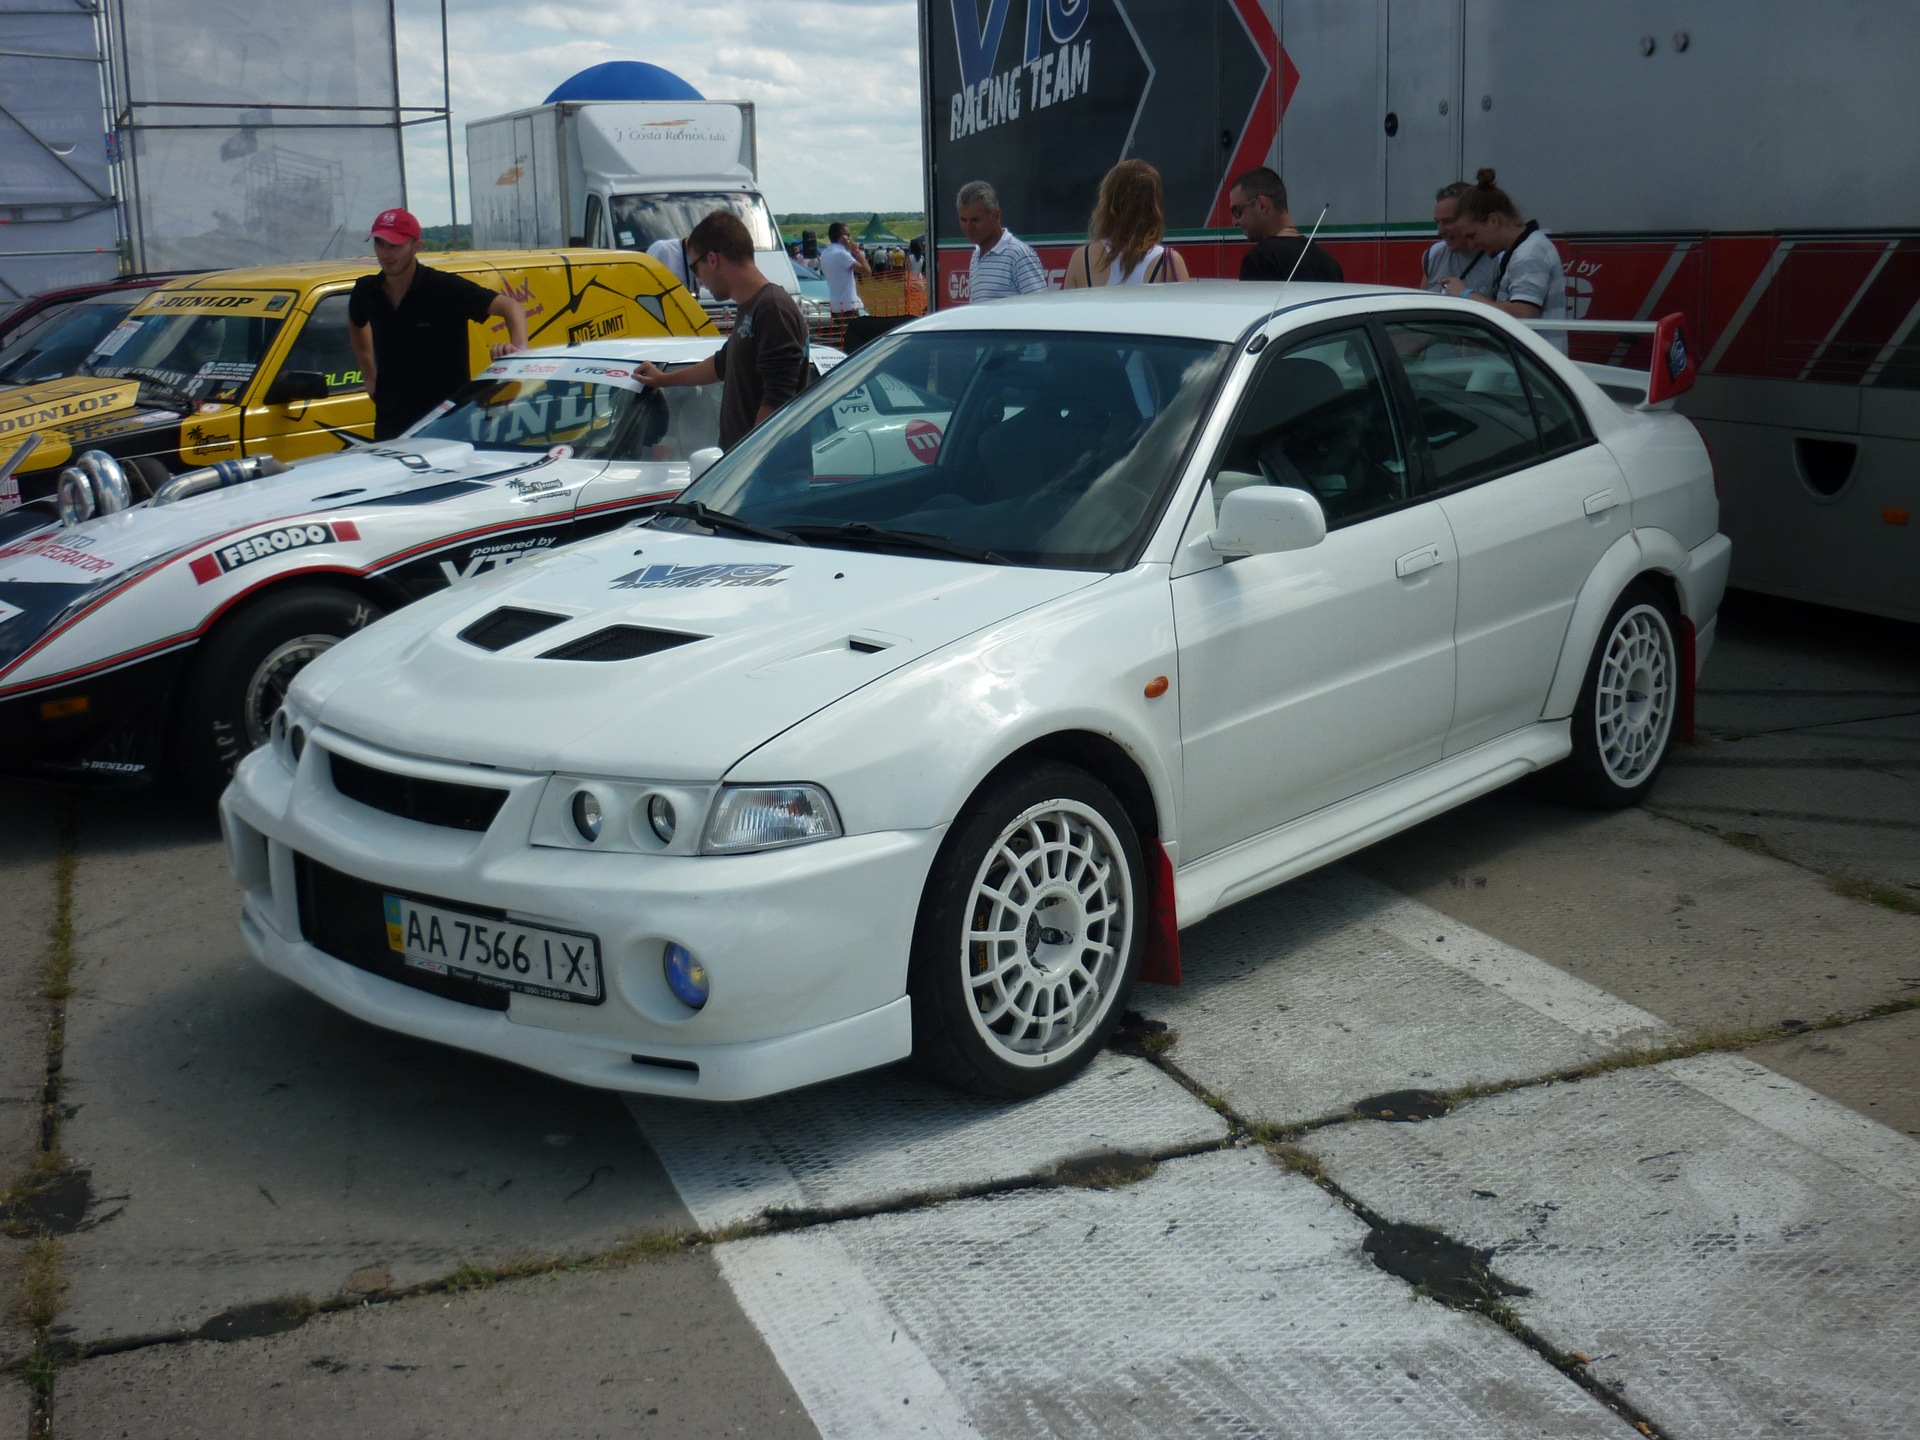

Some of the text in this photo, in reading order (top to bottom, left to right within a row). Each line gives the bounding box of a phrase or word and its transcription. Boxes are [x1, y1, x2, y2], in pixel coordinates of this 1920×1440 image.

[950, 39, 1091, 142] RACING TEAM
[629, 131, 661, 141] Costa
[1577, 260, 1602, 277] by
[162, 296, 256, 308] DUNLOP
[595, 314, 624, 337] LIMIT
[0, 392, 119, 433] DUNLOP
[838, 404, 870, 415] VTG
[222, 525, 326, 568] FERODO
[469, 537, 557, 558] powered by
[608, 578, 788, 590] RACING TEAM
[635, 563, 782, 584] VTG
[90, 761, 146, 772] DUNLOP
[407, 910, 447, 957] AA
[454, 921, 530, 974] 7566
